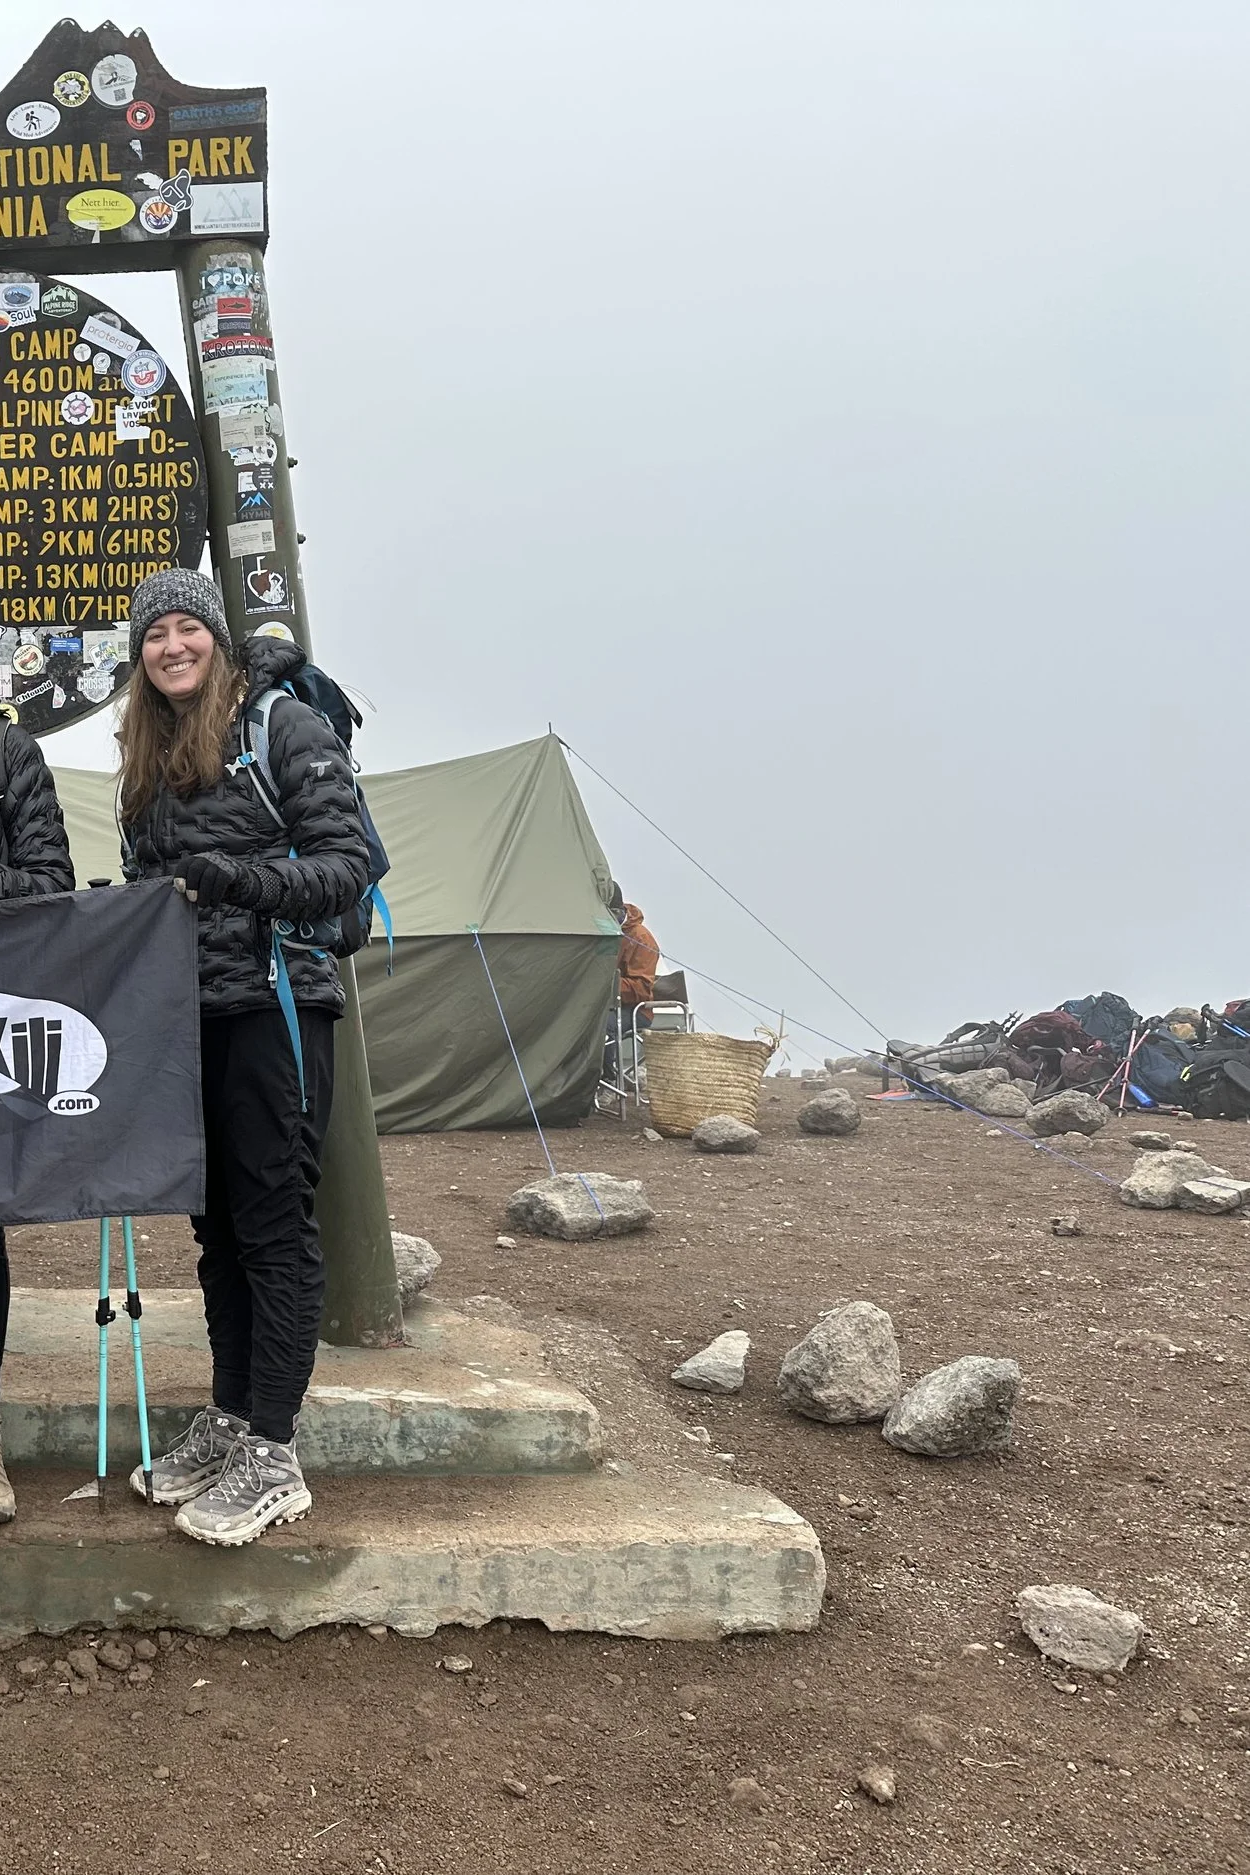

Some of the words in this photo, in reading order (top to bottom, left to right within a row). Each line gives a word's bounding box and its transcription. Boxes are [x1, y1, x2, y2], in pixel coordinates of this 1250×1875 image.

[167, 136, 255, 179] PARK
[81, 198, 101, 208] Nett
[10, 307, 33, 322] soul
[10, 328, 76, 361] CAMP
[87, 322, 134, 353] protergia
[3, 364, 93, 394] 4600M
[50, 431, 124, 459] CAMP
[241, 509, 271, 520] HYMN
[38, 529, 94, 557] 9KM
[99, 524, 180, 560] (6HRS)
